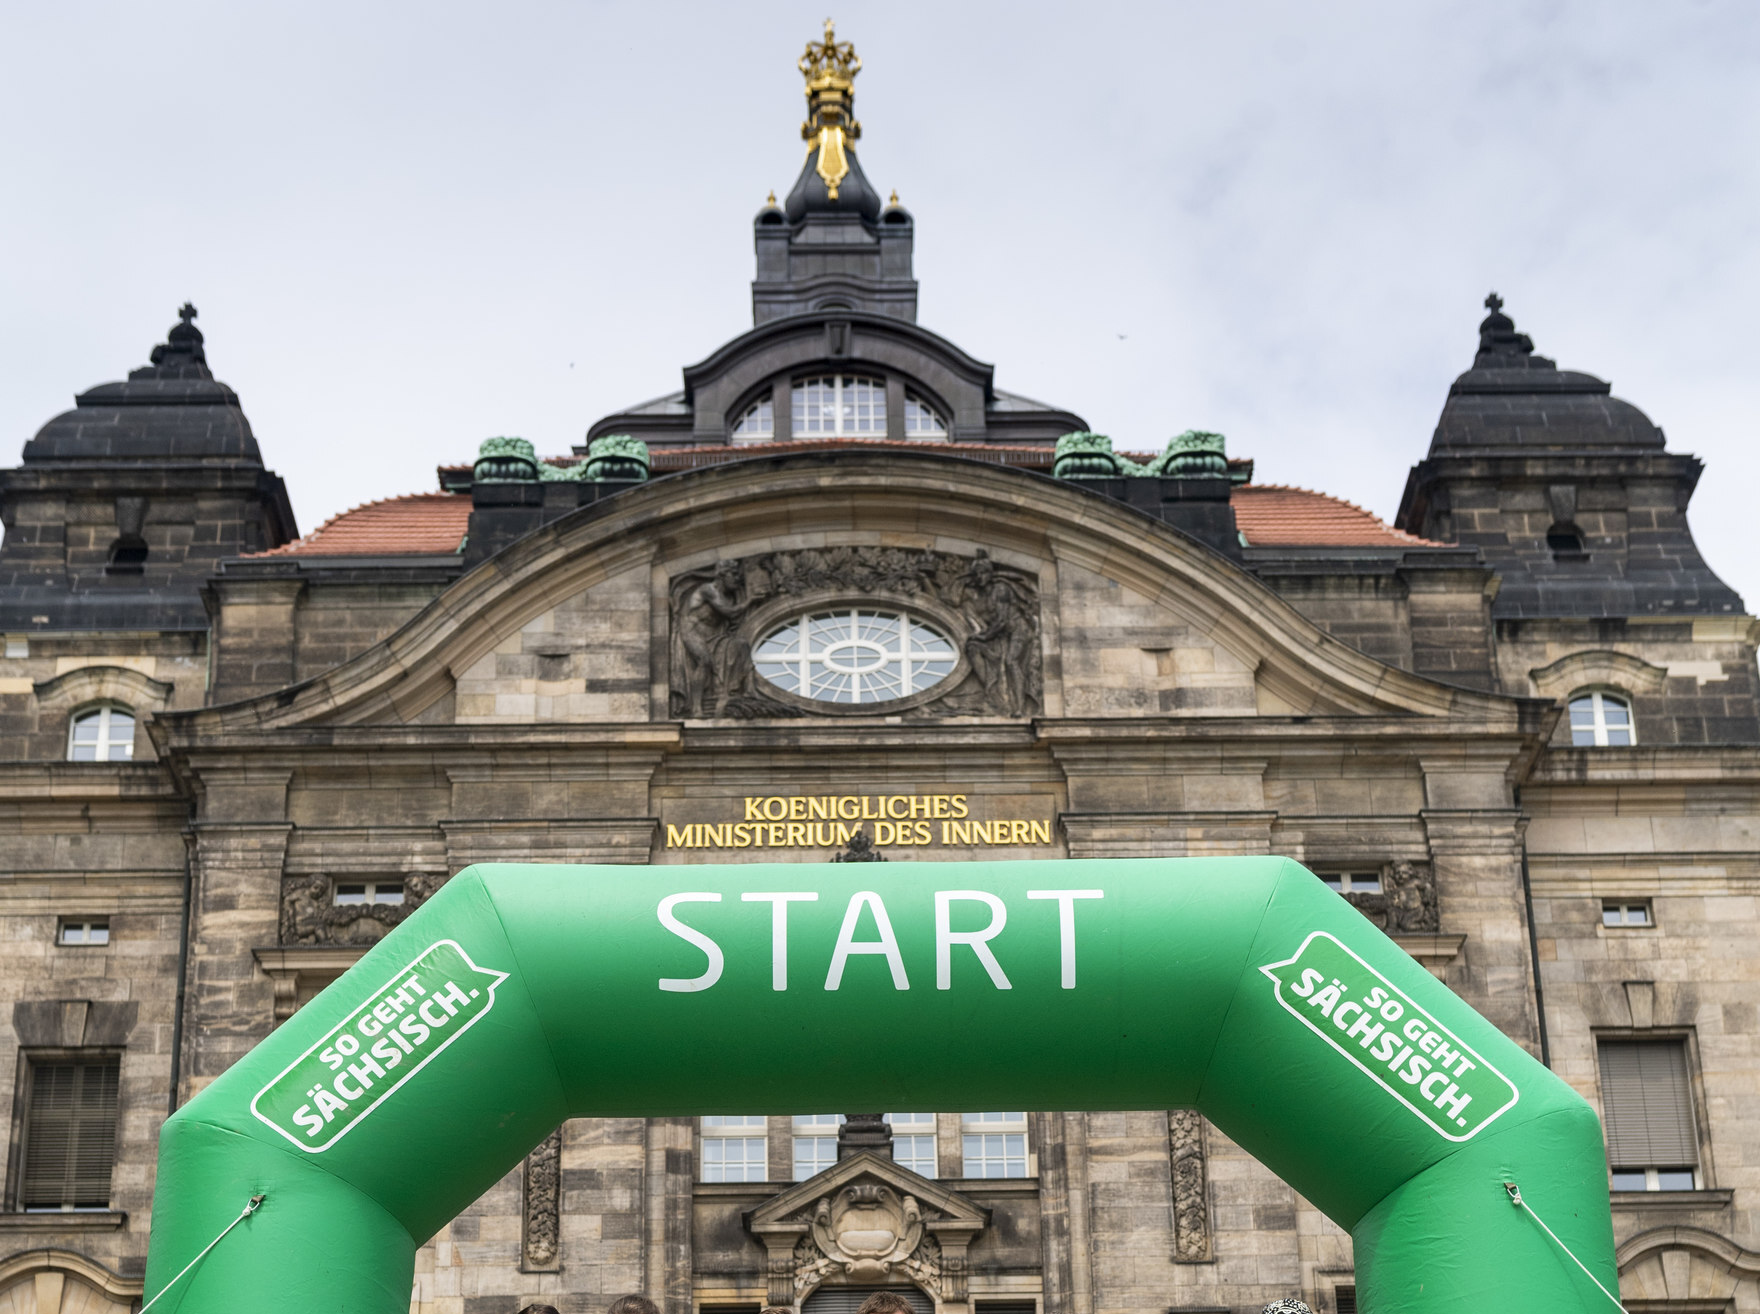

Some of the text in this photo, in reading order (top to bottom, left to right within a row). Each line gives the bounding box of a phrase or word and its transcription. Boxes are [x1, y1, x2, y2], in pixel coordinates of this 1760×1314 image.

[666, 820, 1052, 848] MINISTERIUM DES INNERN
[744, 795, 969, 821] KOENIGLICHES
[657, 890, 1104, 993] START
[292, 980, 480, 1138] SÄCHSISCH.
[319, 974, 427, 1071] SO GEHT
[1290, 968, 1473, 1128] SÄCHSISCH.
[1362, 987, 1477, 1078] SO GEHT
